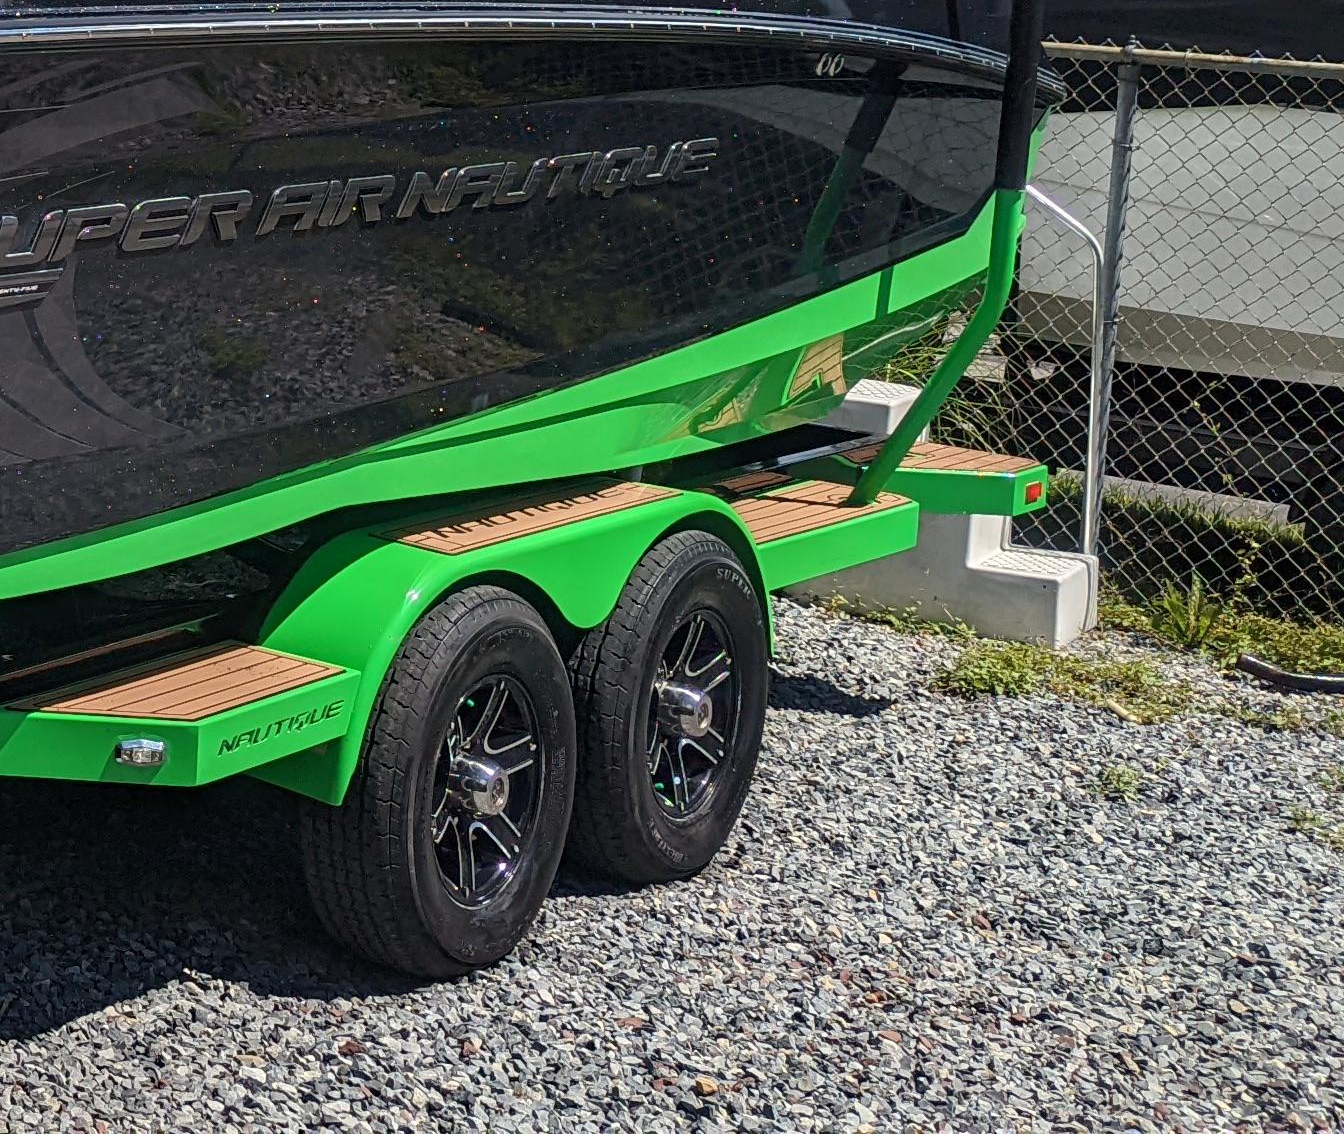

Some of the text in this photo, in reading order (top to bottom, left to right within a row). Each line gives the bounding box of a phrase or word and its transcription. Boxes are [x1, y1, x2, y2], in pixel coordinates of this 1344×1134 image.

[255, 174, 396, 237] AIR
[397, 137, 719, 220] NAUTIQUE
[217, 699, 345, 757] NAUTIQUE
